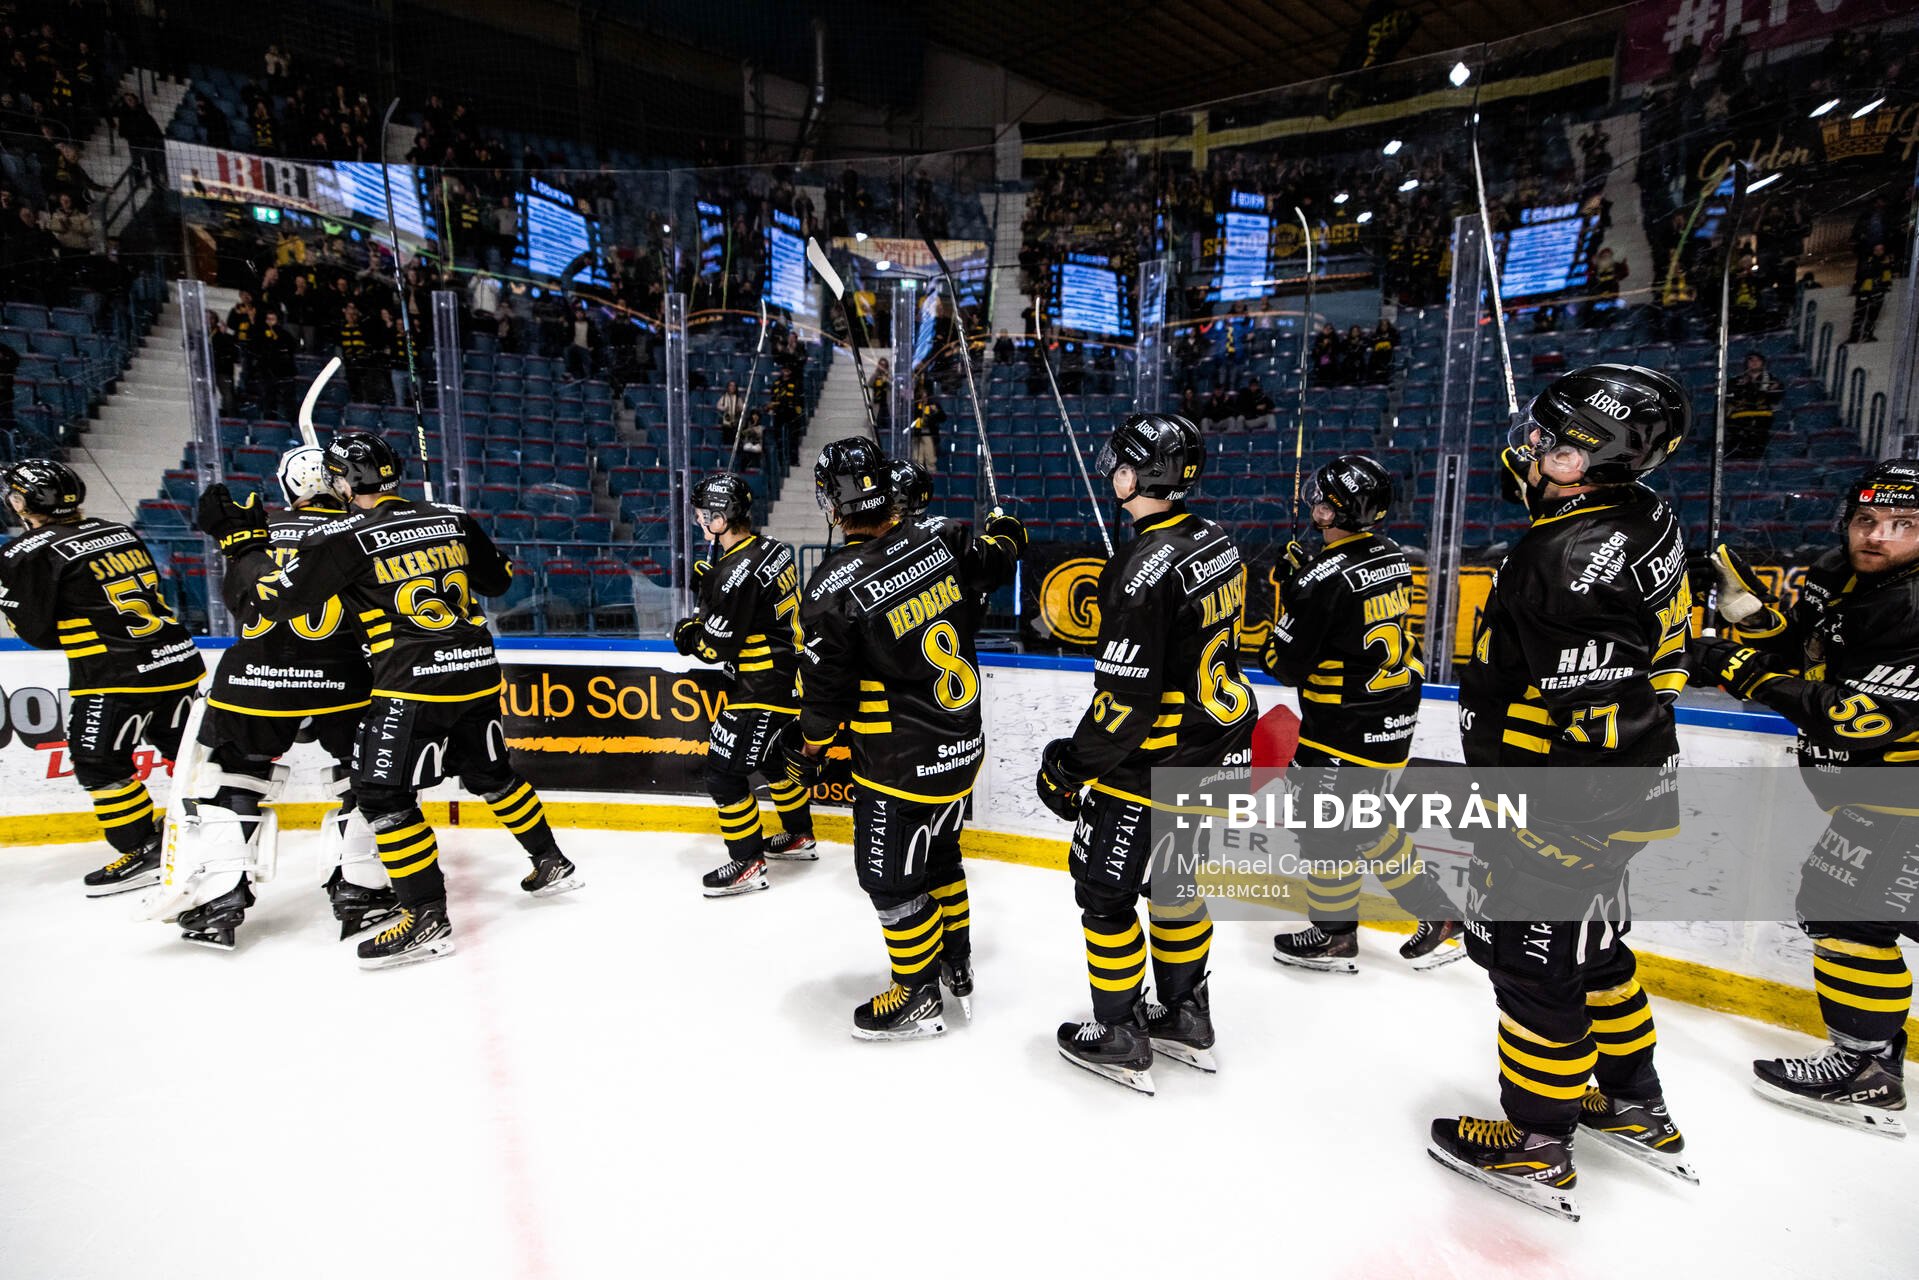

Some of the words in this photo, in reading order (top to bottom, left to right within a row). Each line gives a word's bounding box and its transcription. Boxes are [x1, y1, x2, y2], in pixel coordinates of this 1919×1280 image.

[1566, 428, 1600, 445] CCM
[380, 464, 394, 477] 62
[1183, 465, 1197, 479] 67
[1872, 483, 1914, 491] CCM
[1876, 491, 1915, 500] SVENSKA
[370, 519, 458, 548] Bemannia
[886, 538, 909, 556] CCM
[721, 557, 751, 594] Sundsten
[811, 558, 864, 601] Sundsten
[864, 546, 949, 603] Bemannia
[1125, 543, 1175, 597] Sundsten
[1145, 561, 1172, 588] Måleri
[1189, 541, 1240, 584] Bemannia
[1297, 552, 1348, 588] Sundsten
[1570, 531, 1629, 594] Sundsten
[1600, 549, 1627, 584] Måleri
[394, 569, 488, 632] 62
[828, 574, 855, 595] Måleri
[885, 574, 963, 640] HEDBERG
[1102, 638, 1141, 664] HÅJ
[1476, 627, 1492, 664] A
[1557, 639, 1615, 674] HÅJ
[228, 674, 346, 691] Emballagehantering
[245, 663, 325, 679] Sollentuna
[921, 619, 979, 712] 8
[586, 676, 661, 721] Sol
[1093, 690, 1133, 734] 67
[1828, 693, 1893, 739] 59
[722, 711, 738, 722] CCM
[746, 711, 772, 767] JÄRFÄLLA
[373, 748, 393, 779] KÖK
[1843, 807, 1873, 827] CCM
[869, 800, 888, 878] JÄRFÄLLA
[1106, 803, 1143, 881] JÄRFÄLL
[1522, 1164, 1562, 1182] CCM
